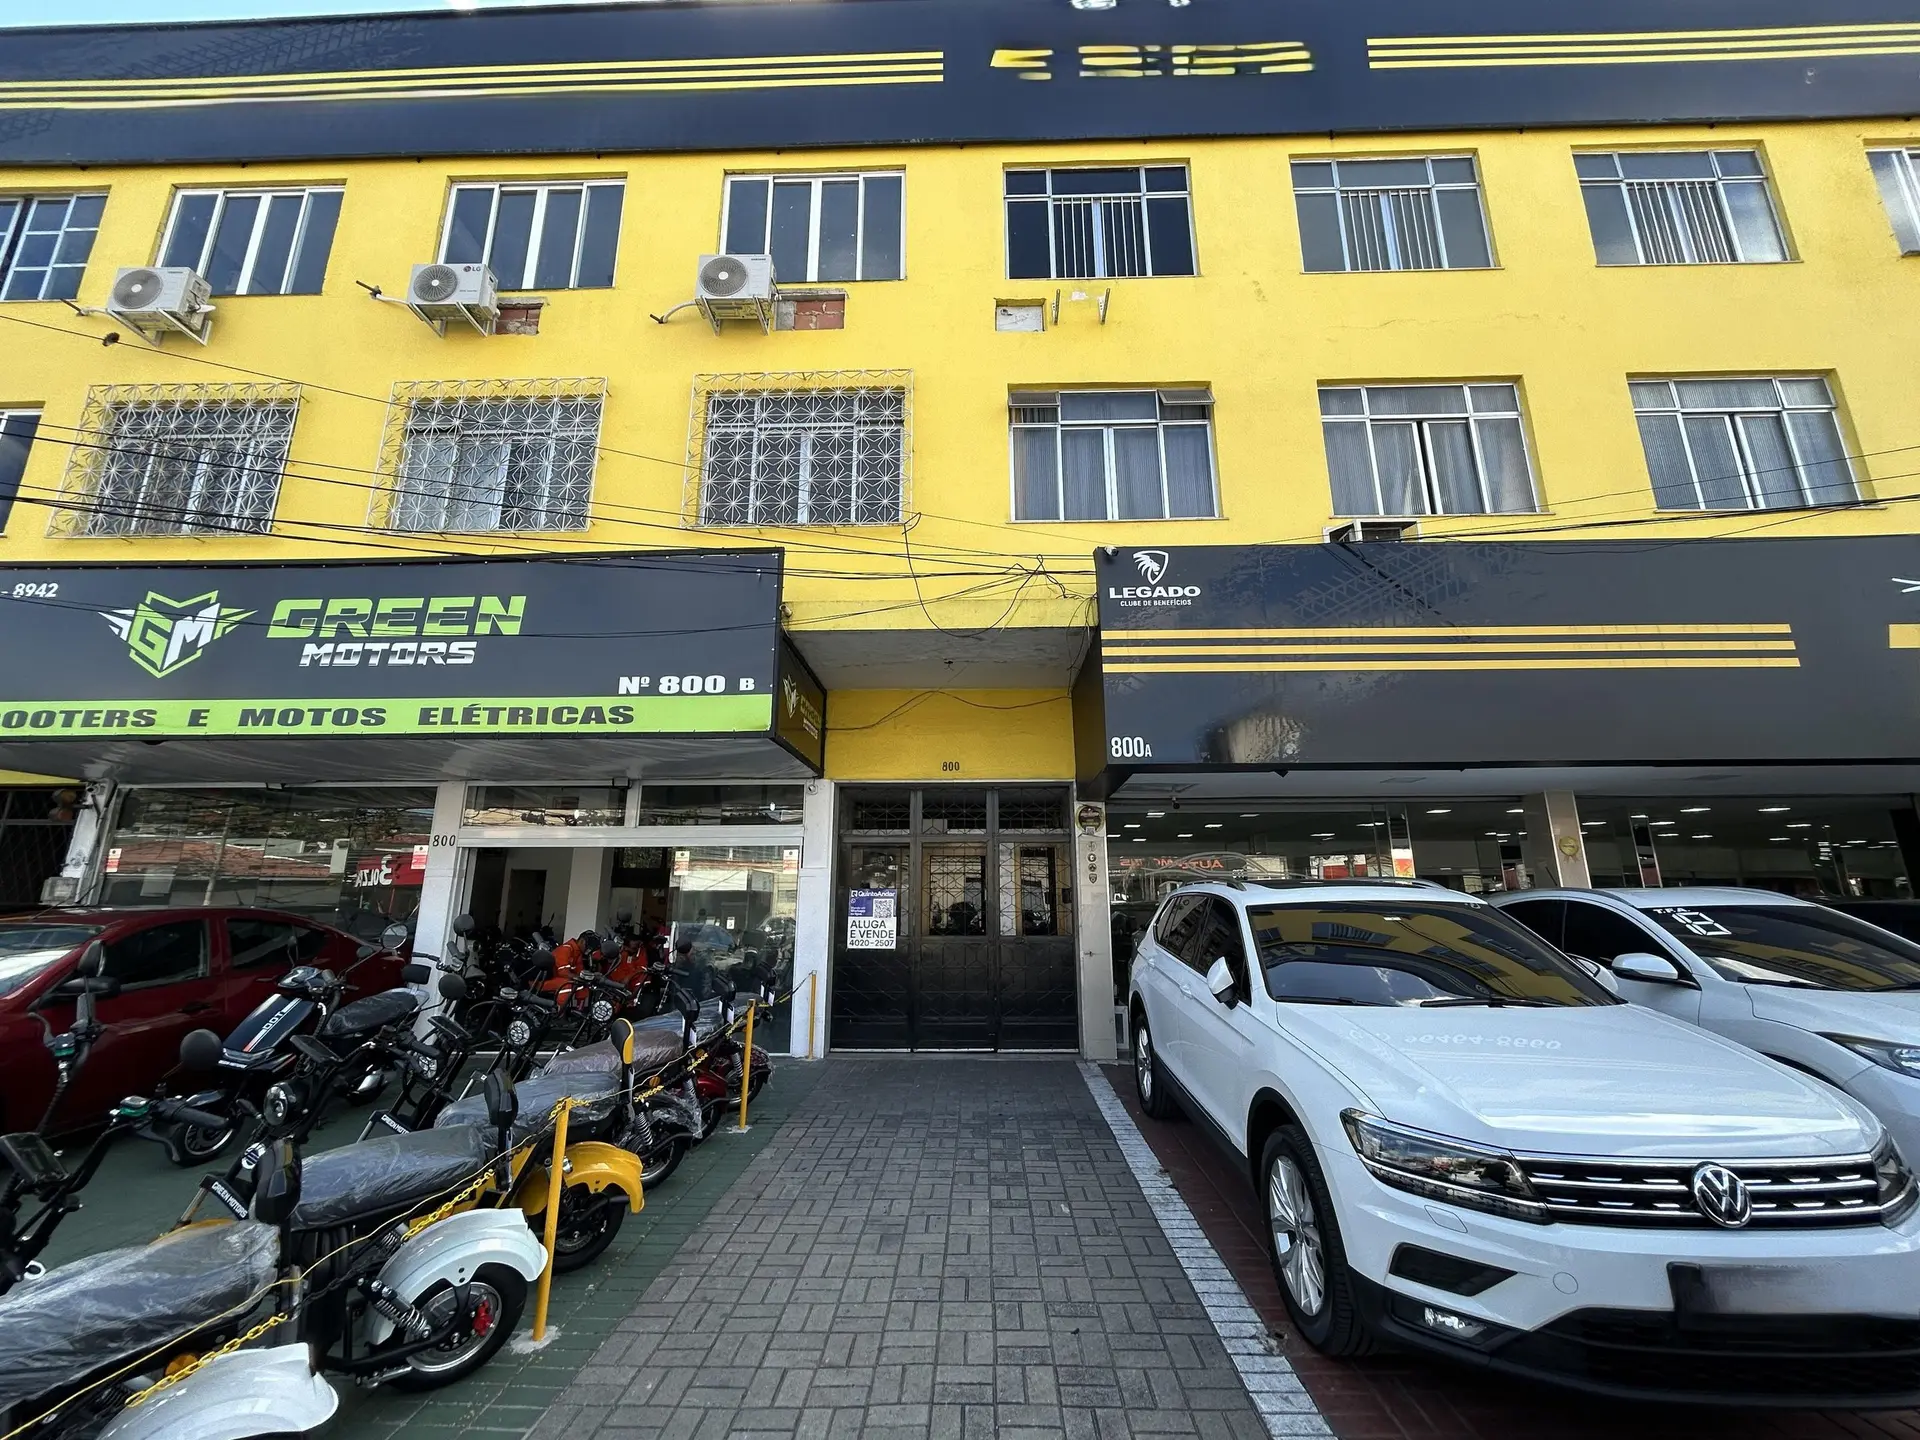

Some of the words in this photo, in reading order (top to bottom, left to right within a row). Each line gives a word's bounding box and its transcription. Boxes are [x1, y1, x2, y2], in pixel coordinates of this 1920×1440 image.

[12, 583, 59, 598] 8942
[1109, 586, 1201, 599] LEGADO
[1153, 598, 1192, 606] BENEFÍCIOS
[266, 595, 527, 638] GREEN
[127, 602, 221, 671] GM
[299, 641, 478, 667] MOTORS
[658, 675, 726, 694] 800
[739, 677, 755, 691] B
[187, 708, 210, 727] E
[237, 707, 387, 727] MOTOS
[417, 704, 635, 726] ELÉTRICAS
[1110, 736, 1152, 758] 800A
[941, 761, 960, 772] 800
[433, 834, 456, 847] 800
[850, 919, 887, 929] ALUGA
[850, 929, 856, 939] E
[858, 929, 894, 939] VENDE
[848, 939, 894, 947] 4020-2507
[211, 1181, 231, 1202] GREEN
[226, 1195, 249, 1219] MOTORS
